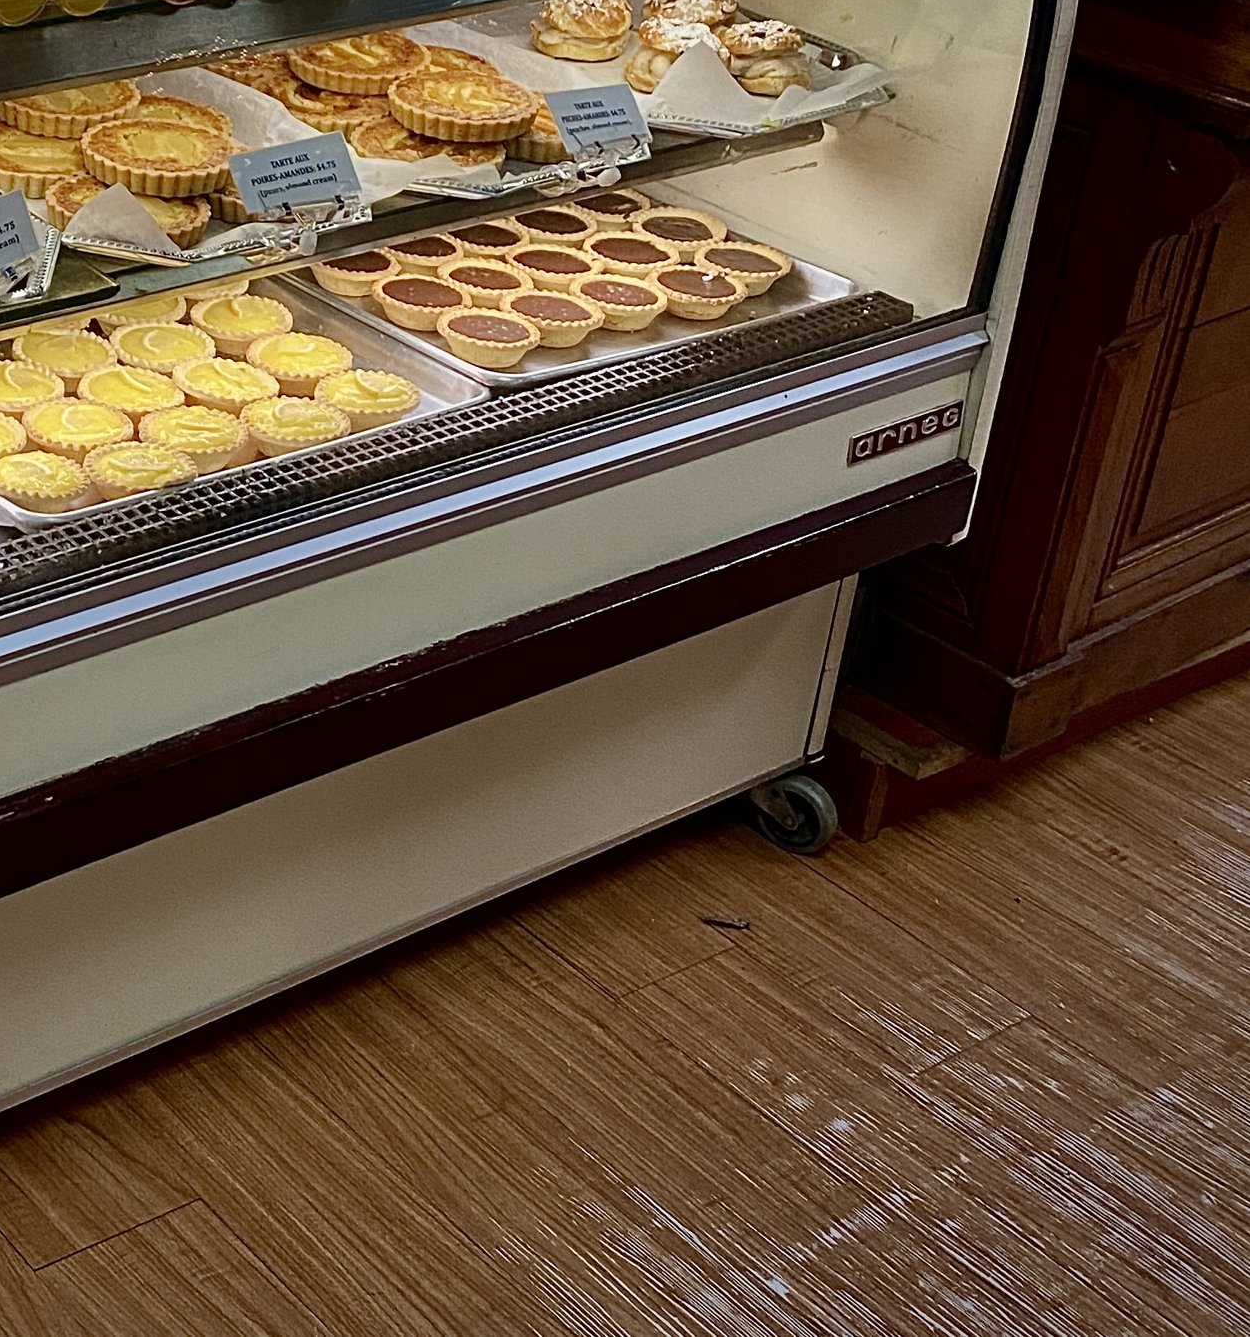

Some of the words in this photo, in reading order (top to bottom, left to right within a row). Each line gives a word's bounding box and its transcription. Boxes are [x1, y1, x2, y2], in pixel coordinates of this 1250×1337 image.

[270, 157, 295, 169] TARTE
[295, 153, 310, 164] AUX
[251, 166, 316, 186] POIRES-AMANDES:
[317, 160, 336, 172] $4.75
[285, 179, 312, 191] almond
[313, 173, 337, 185] cream)
